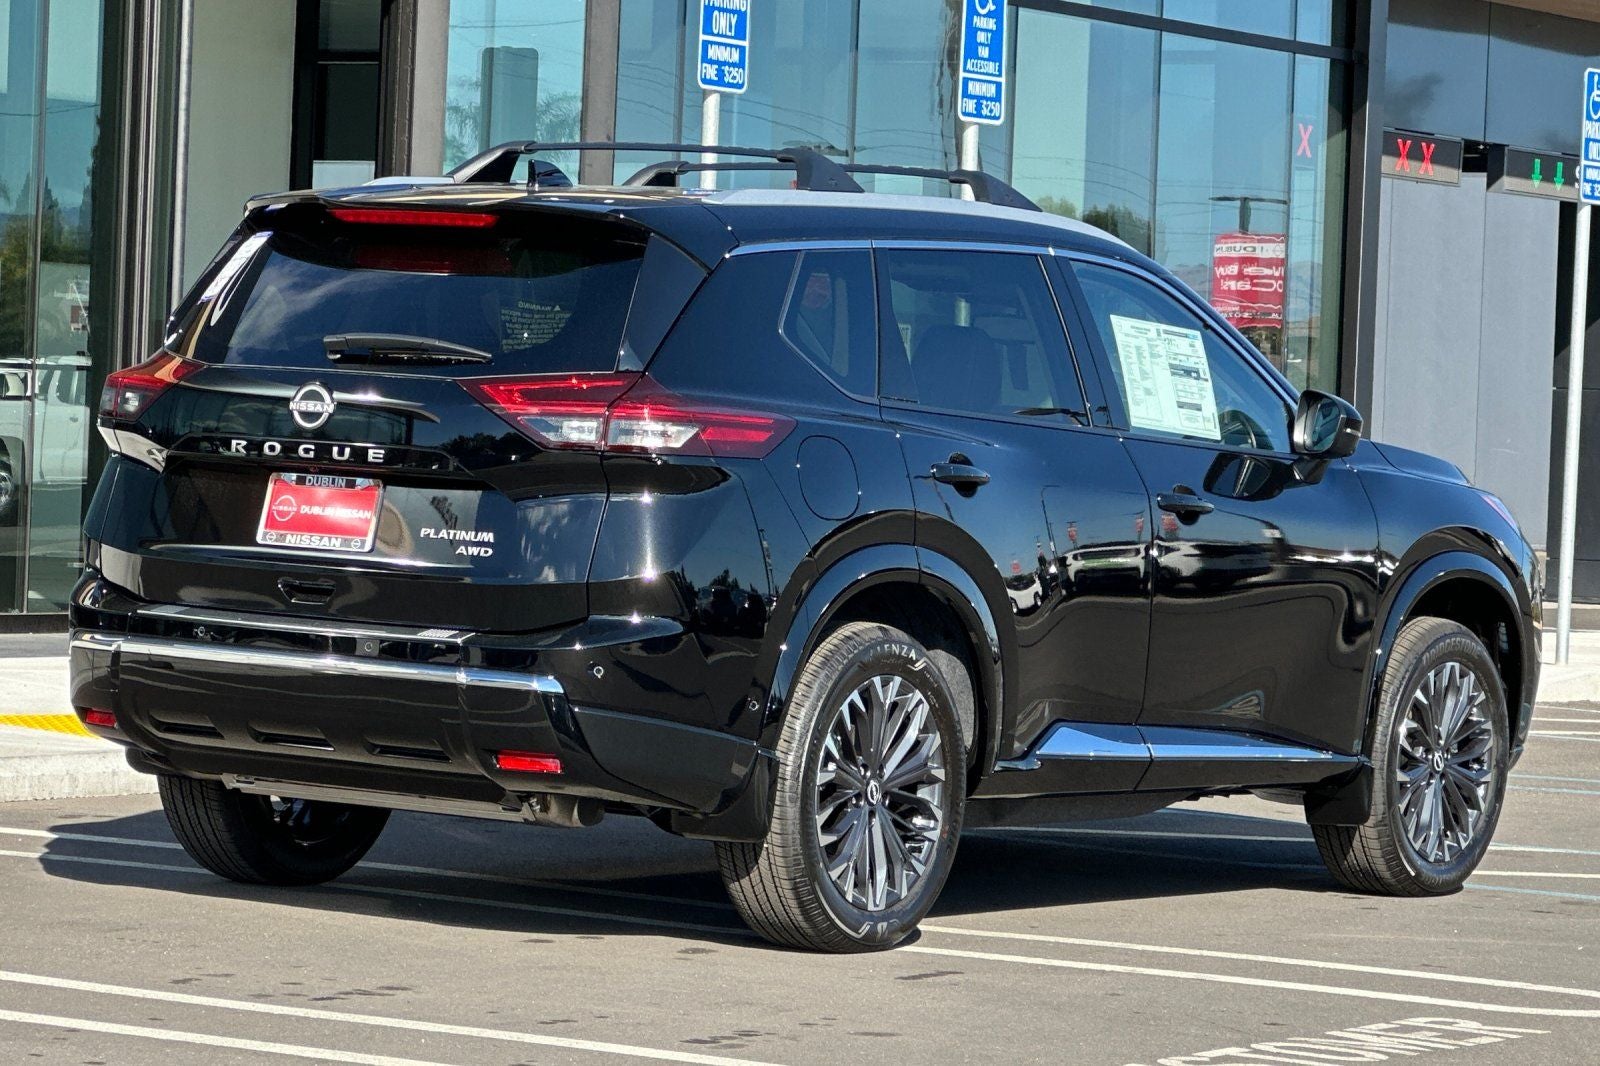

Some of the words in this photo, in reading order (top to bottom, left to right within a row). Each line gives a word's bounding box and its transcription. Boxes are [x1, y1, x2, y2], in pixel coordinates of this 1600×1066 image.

[712, 10, 737, 36] ONLY
[973, 15, 997, 31] PARKING
[976, 31, 992, 44] ONLY
[707, 44, 740, 64] MINIMUM
[978, 45, 989, 58] VAN
[702, 63, 718, 80] FINE
[724, 66, 744, 84] $250
[966, 59, 1000, 75] ACCESSIBLE
[967, 80, 996, 98] MINIMUM
[962, 98, 977, 114] FINE
[981, 101, 1000, 117] $250
[289, 401, 336, 413] NISSAN
[230, 439, 385, 463] ROGUE
[305, 476, 346, 488] DUBLIN
[300, 505, 334, 517] DUBLIN
[334, 507, 373, 520] NISSAN
[285, 534, 342, 548] NISSAN
[420, 527, 494, 543] PLATINUM
[455, 545, 493, 557] AWD
